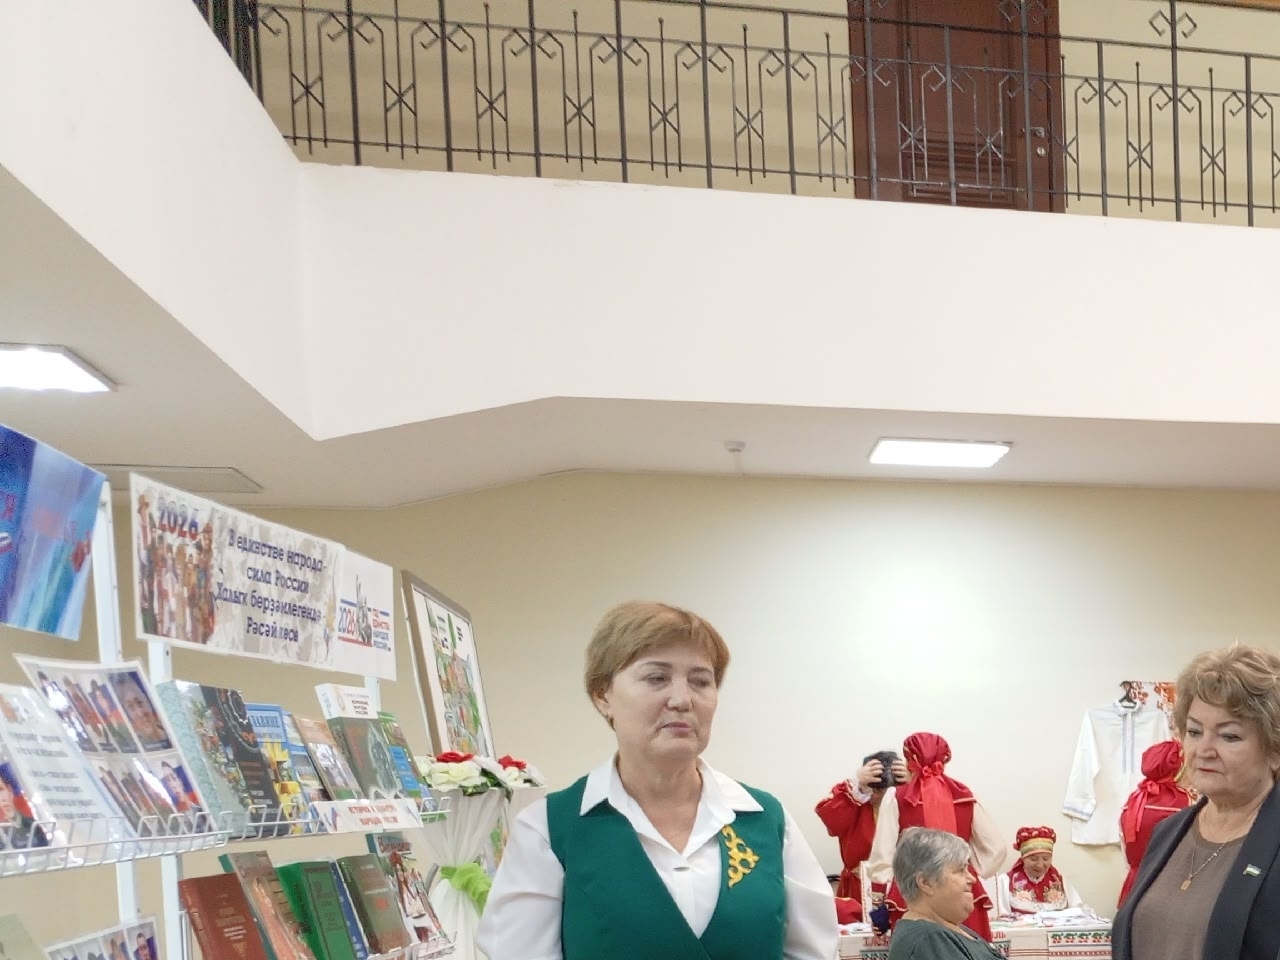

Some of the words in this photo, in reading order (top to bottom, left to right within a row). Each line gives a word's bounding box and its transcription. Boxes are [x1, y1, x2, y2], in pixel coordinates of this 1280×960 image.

[157, 496, 199, 541] 2026
[236, 536, 285, 561] единстве
[246, 567, 272, 585] сила
[274, 570, 310, 594] России
